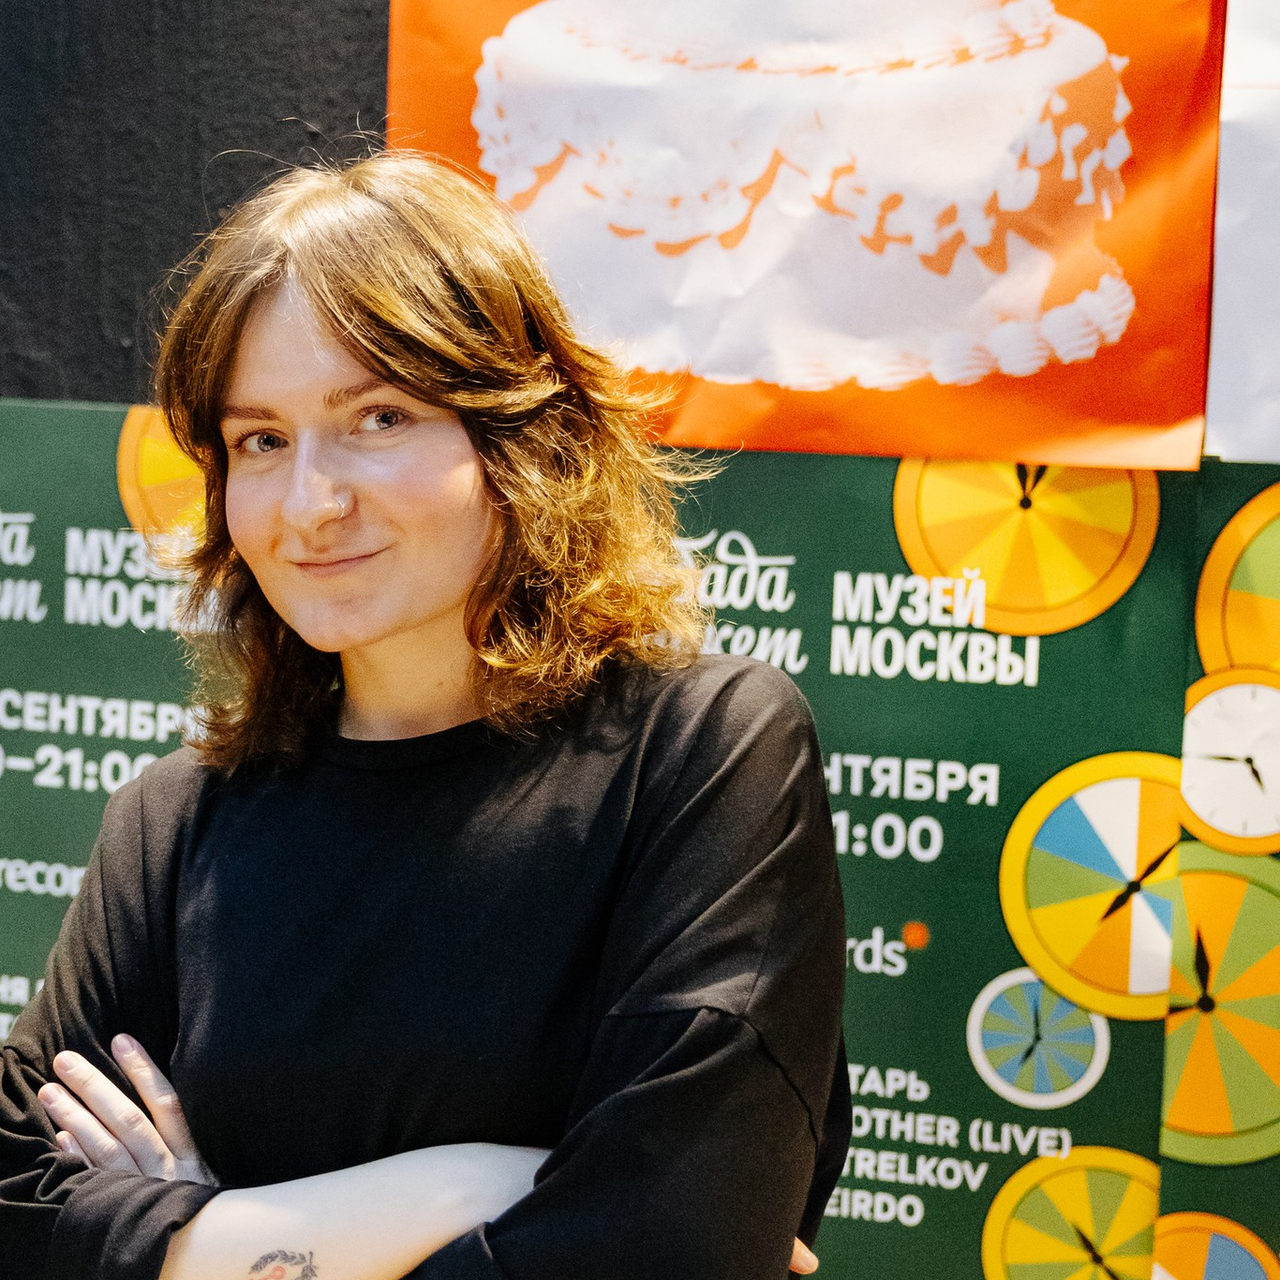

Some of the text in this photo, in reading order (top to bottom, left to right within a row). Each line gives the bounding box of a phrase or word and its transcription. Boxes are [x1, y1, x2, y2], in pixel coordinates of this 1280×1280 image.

[832, 567, 986, 629] МУЗЕЙ
[829, 626, 1040, 687] МОСКВЫ
[968, 1118, 1073, 1161] (LIVE)
